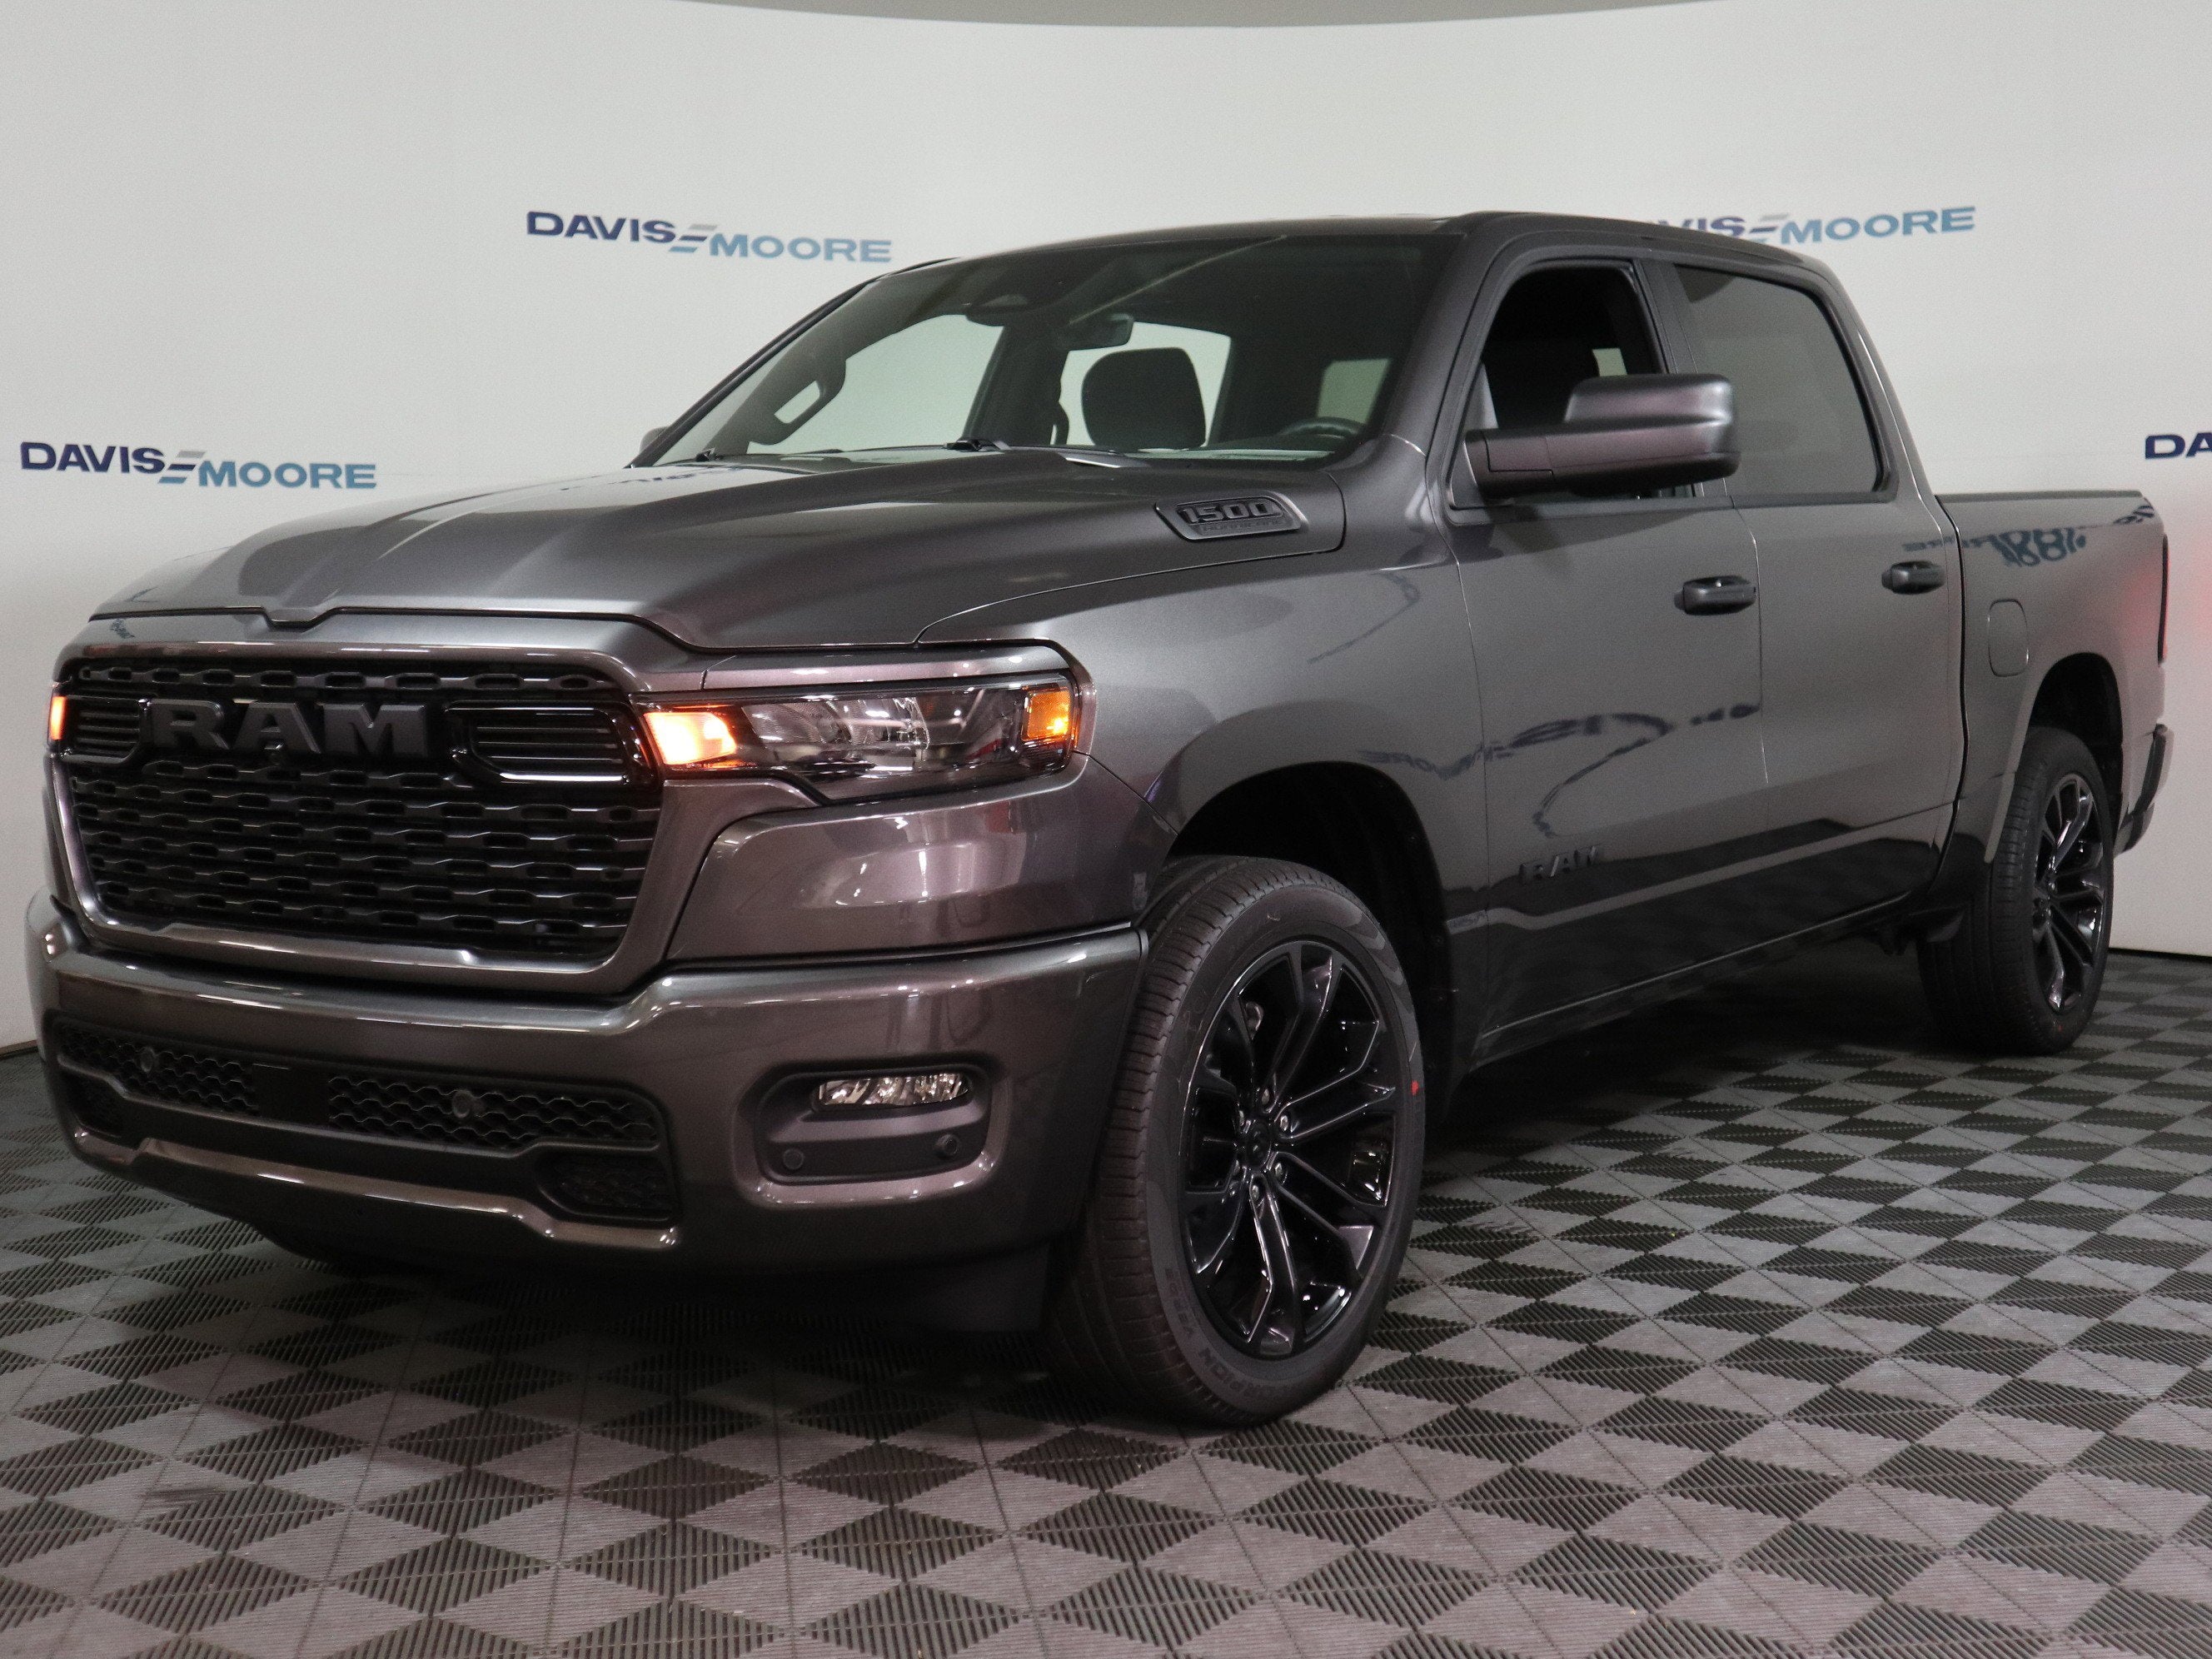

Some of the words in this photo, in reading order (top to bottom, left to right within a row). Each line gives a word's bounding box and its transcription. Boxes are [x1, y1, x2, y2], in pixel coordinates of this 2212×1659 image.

[526, 211, 676, 243] DAVIS
[710, 232, 893, 263] MOORE
[1780, 206, 1976, 245] MOORE
[20, 441, 165, 474] DAVIS
[198, 461, 377, 490] MOORE
[1180, 500, 1283, 524] 1500
[142, 698, 430, 757] RAM
